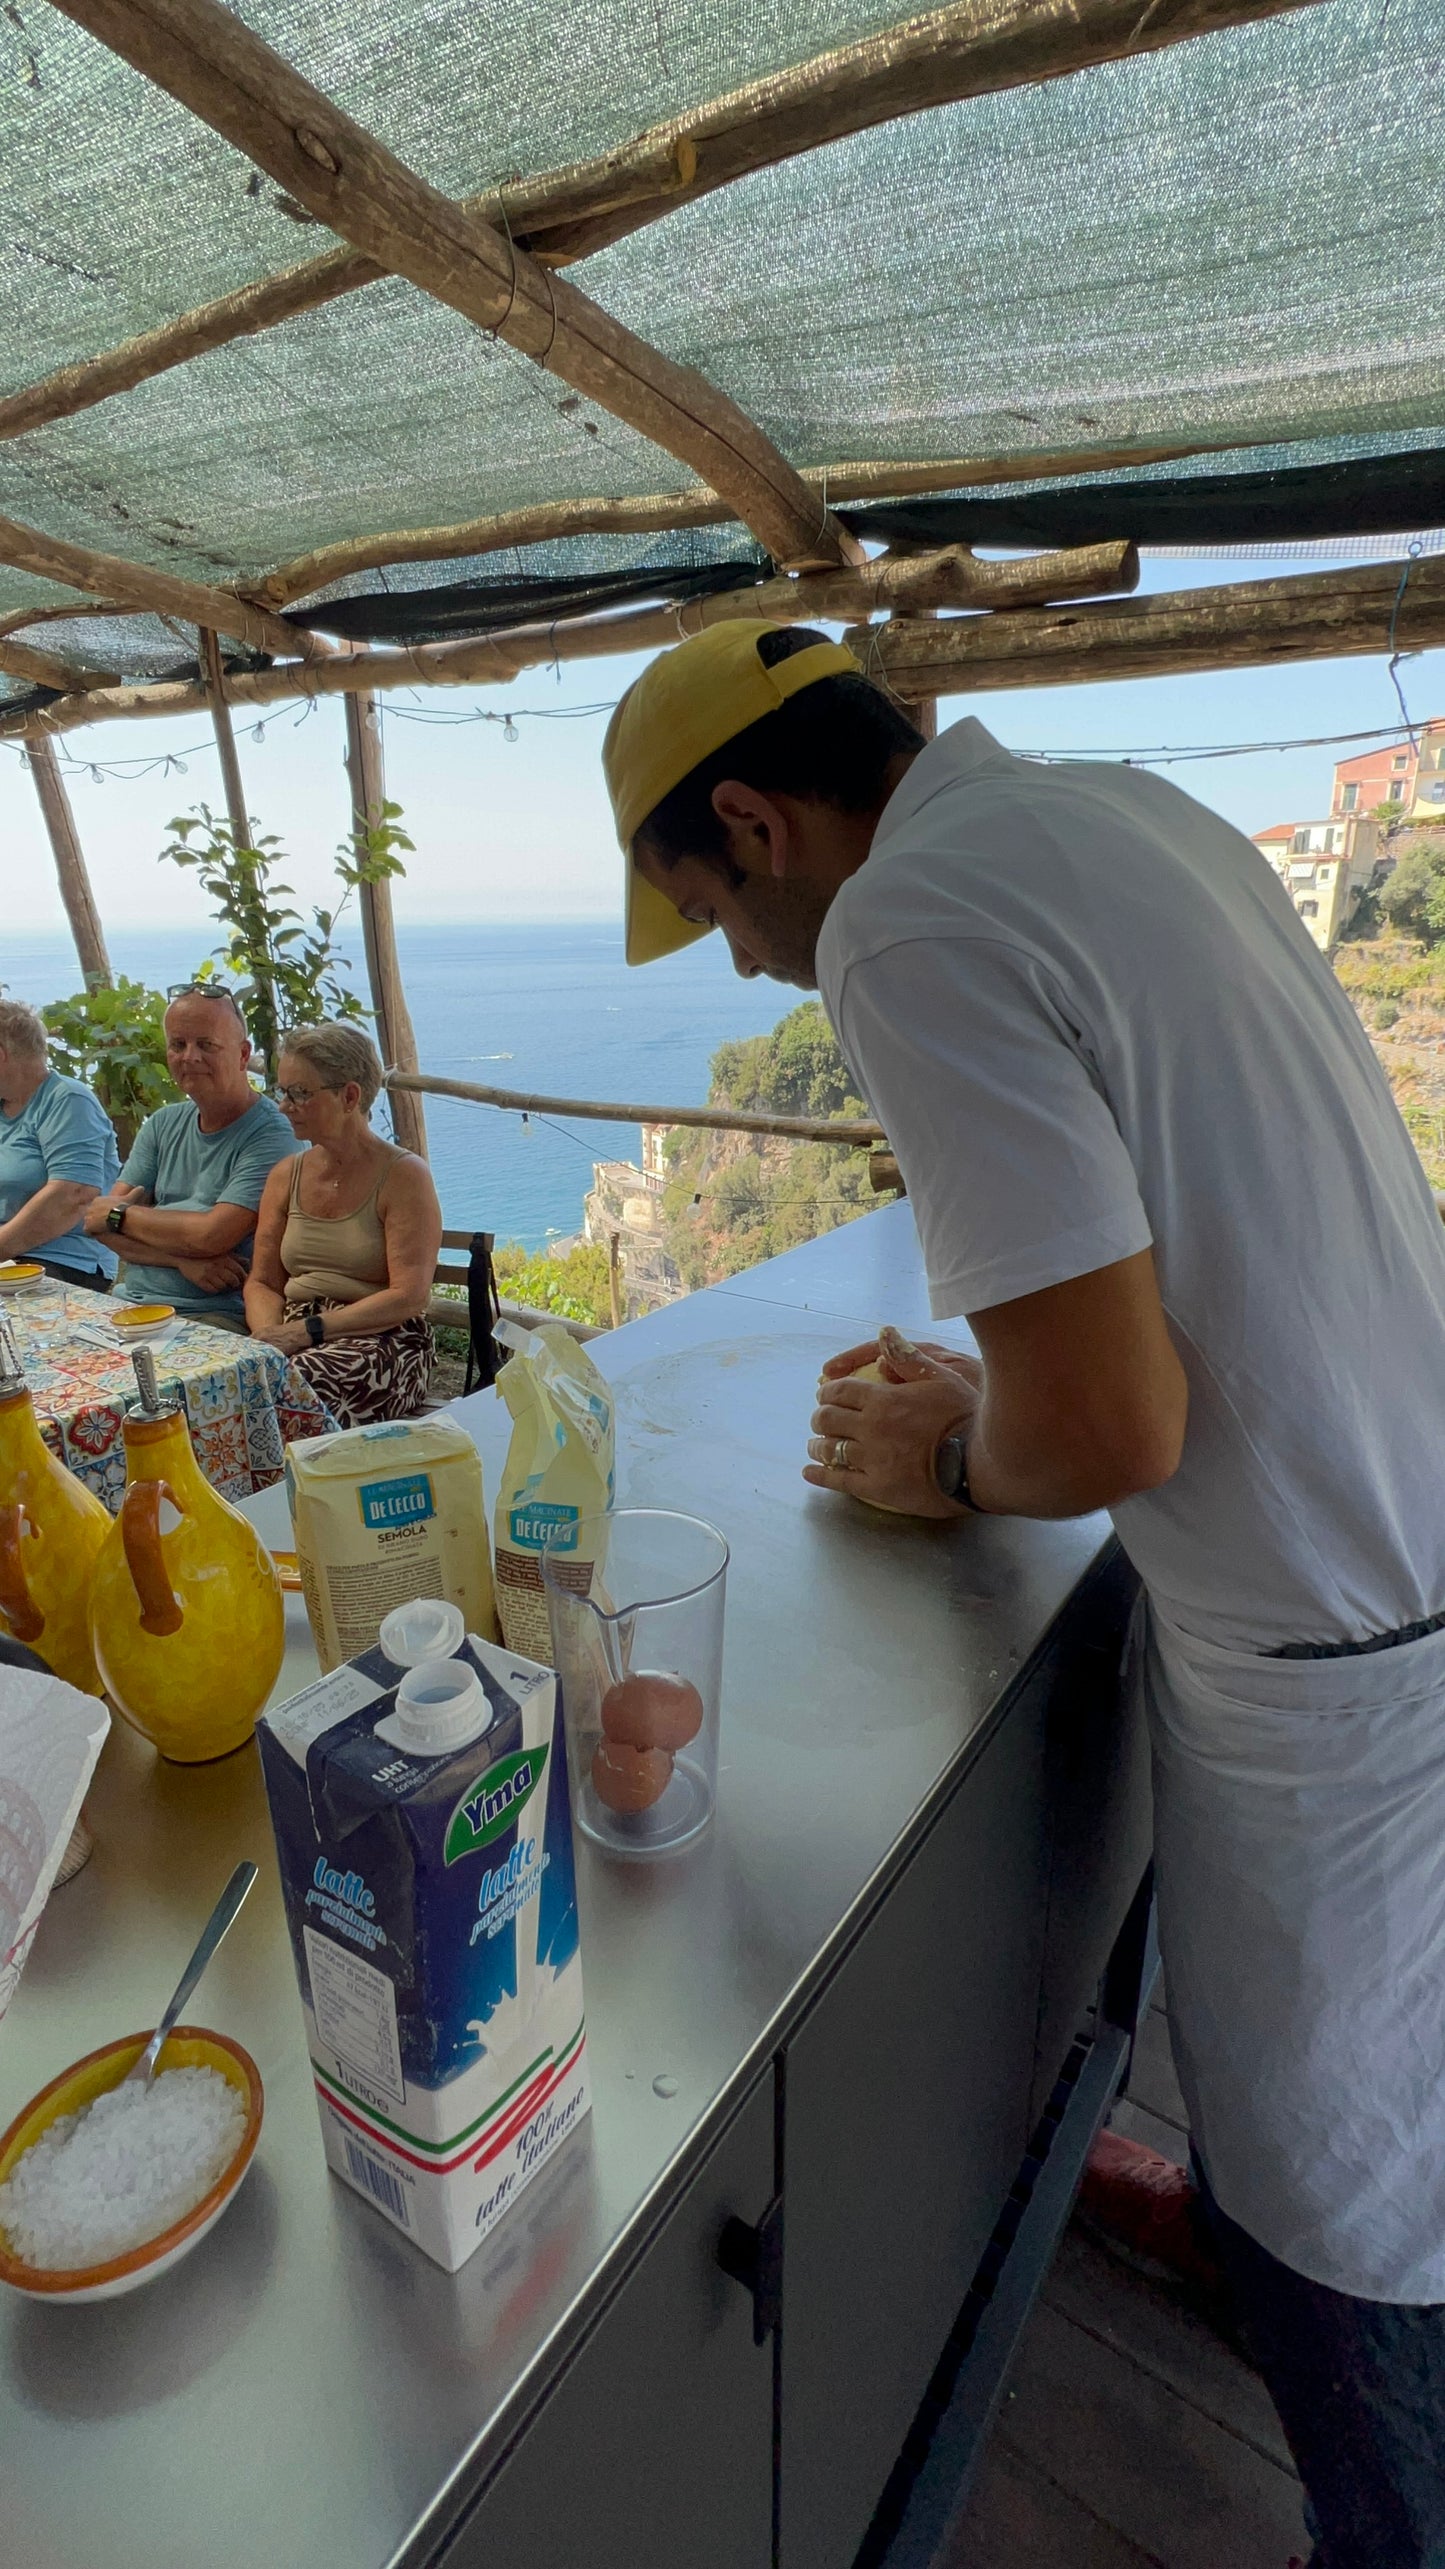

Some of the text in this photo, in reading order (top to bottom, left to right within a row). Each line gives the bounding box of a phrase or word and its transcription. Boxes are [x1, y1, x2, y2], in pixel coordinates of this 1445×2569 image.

[387, 1492, 426, 1516] CECCO
[377, 1524, 427, 1543] SEMOLA
[510, 1670, 529, 1681] 1
[518, 1671, 550, 1695] LITRO
[371, 1759, 409, 1782] UHT
[461, 1760, 534, 1836] Yma
[313, 1855, 376, 1918] latte
[478, 1837, 536, 1913] latte
[335, 2061, 343, 2079] 1
[344, 2071, 376, 2104] LITRO
[516, 2100, 554, 2160] 100%
[475, 2171, 516, 2227] latte
